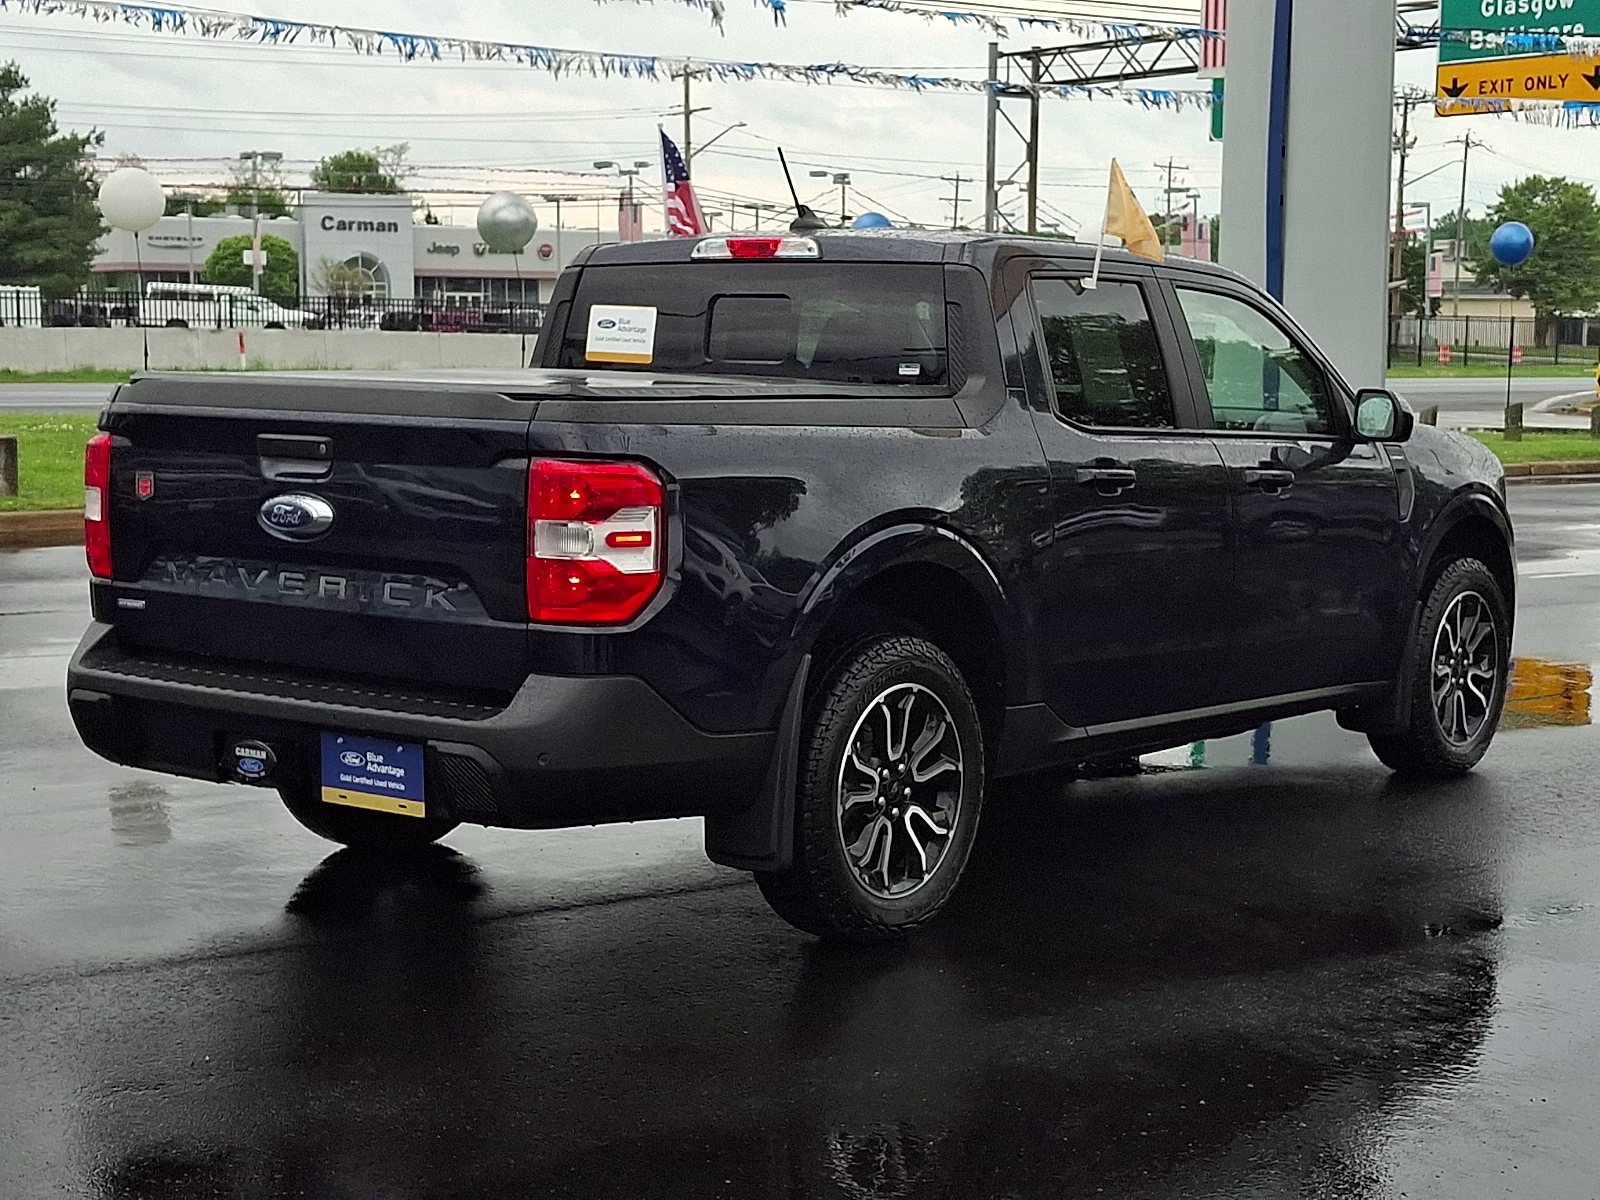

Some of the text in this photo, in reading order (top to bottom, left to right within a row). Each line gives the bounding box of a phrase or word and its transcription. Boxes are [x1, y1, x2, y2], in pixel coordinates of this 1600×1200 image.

[1481, 0, 1575, 19] Glasgow
[1478, 74, 1570, 95] EXIT ONLY
[321, 215, 399, 233] Carman
[427, 242, 460, 257] Jeep
[271, 504, 302, 524] Ford
[235, 746, 267, 760] CARMAN
[343, 752, 362, 765] Ford
[366, 751, 384, 763] Blue
[366, 762, 405, 778] Advantage
[340, 773, 406, 791] Gold Certified Used Vehicle
